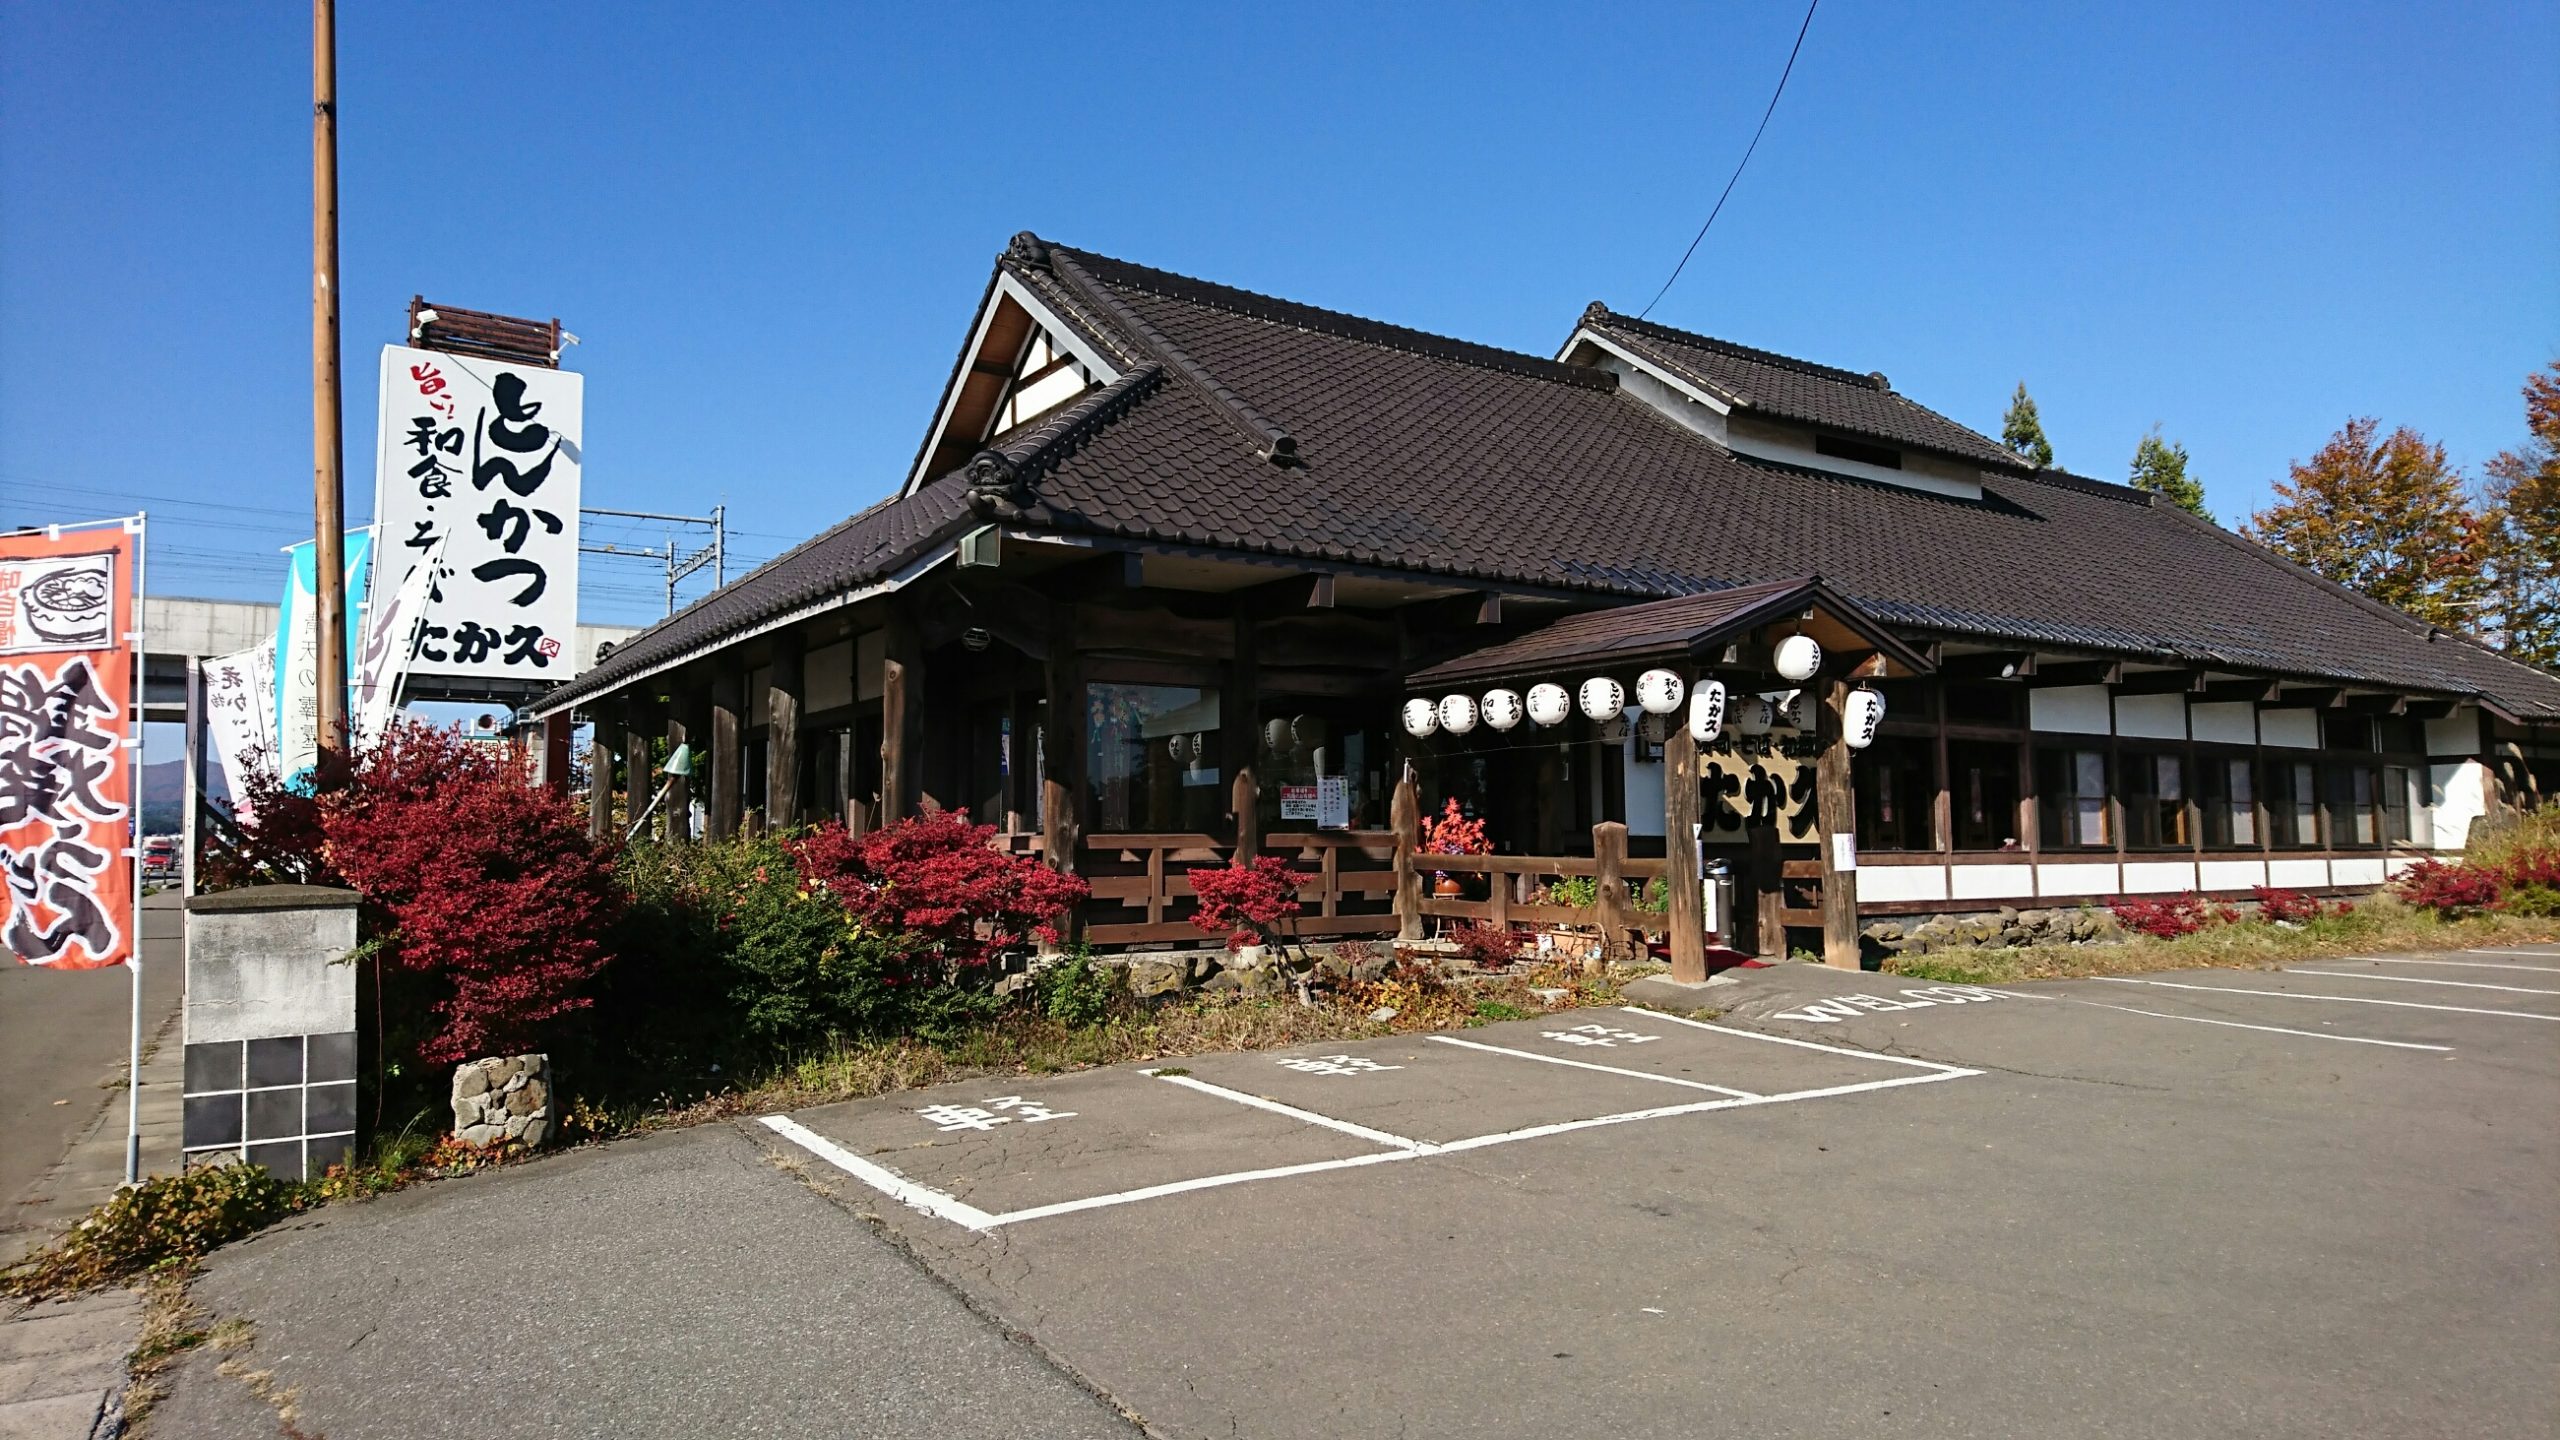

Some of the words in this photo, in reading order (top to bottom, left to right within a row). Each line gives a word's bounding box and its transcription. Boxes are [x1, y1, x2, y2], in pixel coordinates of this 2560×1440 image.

[471, 372, 564, 607] とんかつ
[404, 616, 549, 668] たか久
[1559, 691, 1569, 713] そば
[1609, 682, 1621, 714] とんかつ
[1664, 677, 1678, 701] 和食
[1426, 703, 1439, 728] そば
[1507, 695, 1522, 720] 和食
[1704, 688, 1722, 734] たか久
[1861, 699, 1878, 740] たか久
[1699, 761, 1820, 840] たか久
[1275, 1054, 1405, 1077] 軽
[916, 1095, 1079, 1132] 軽
